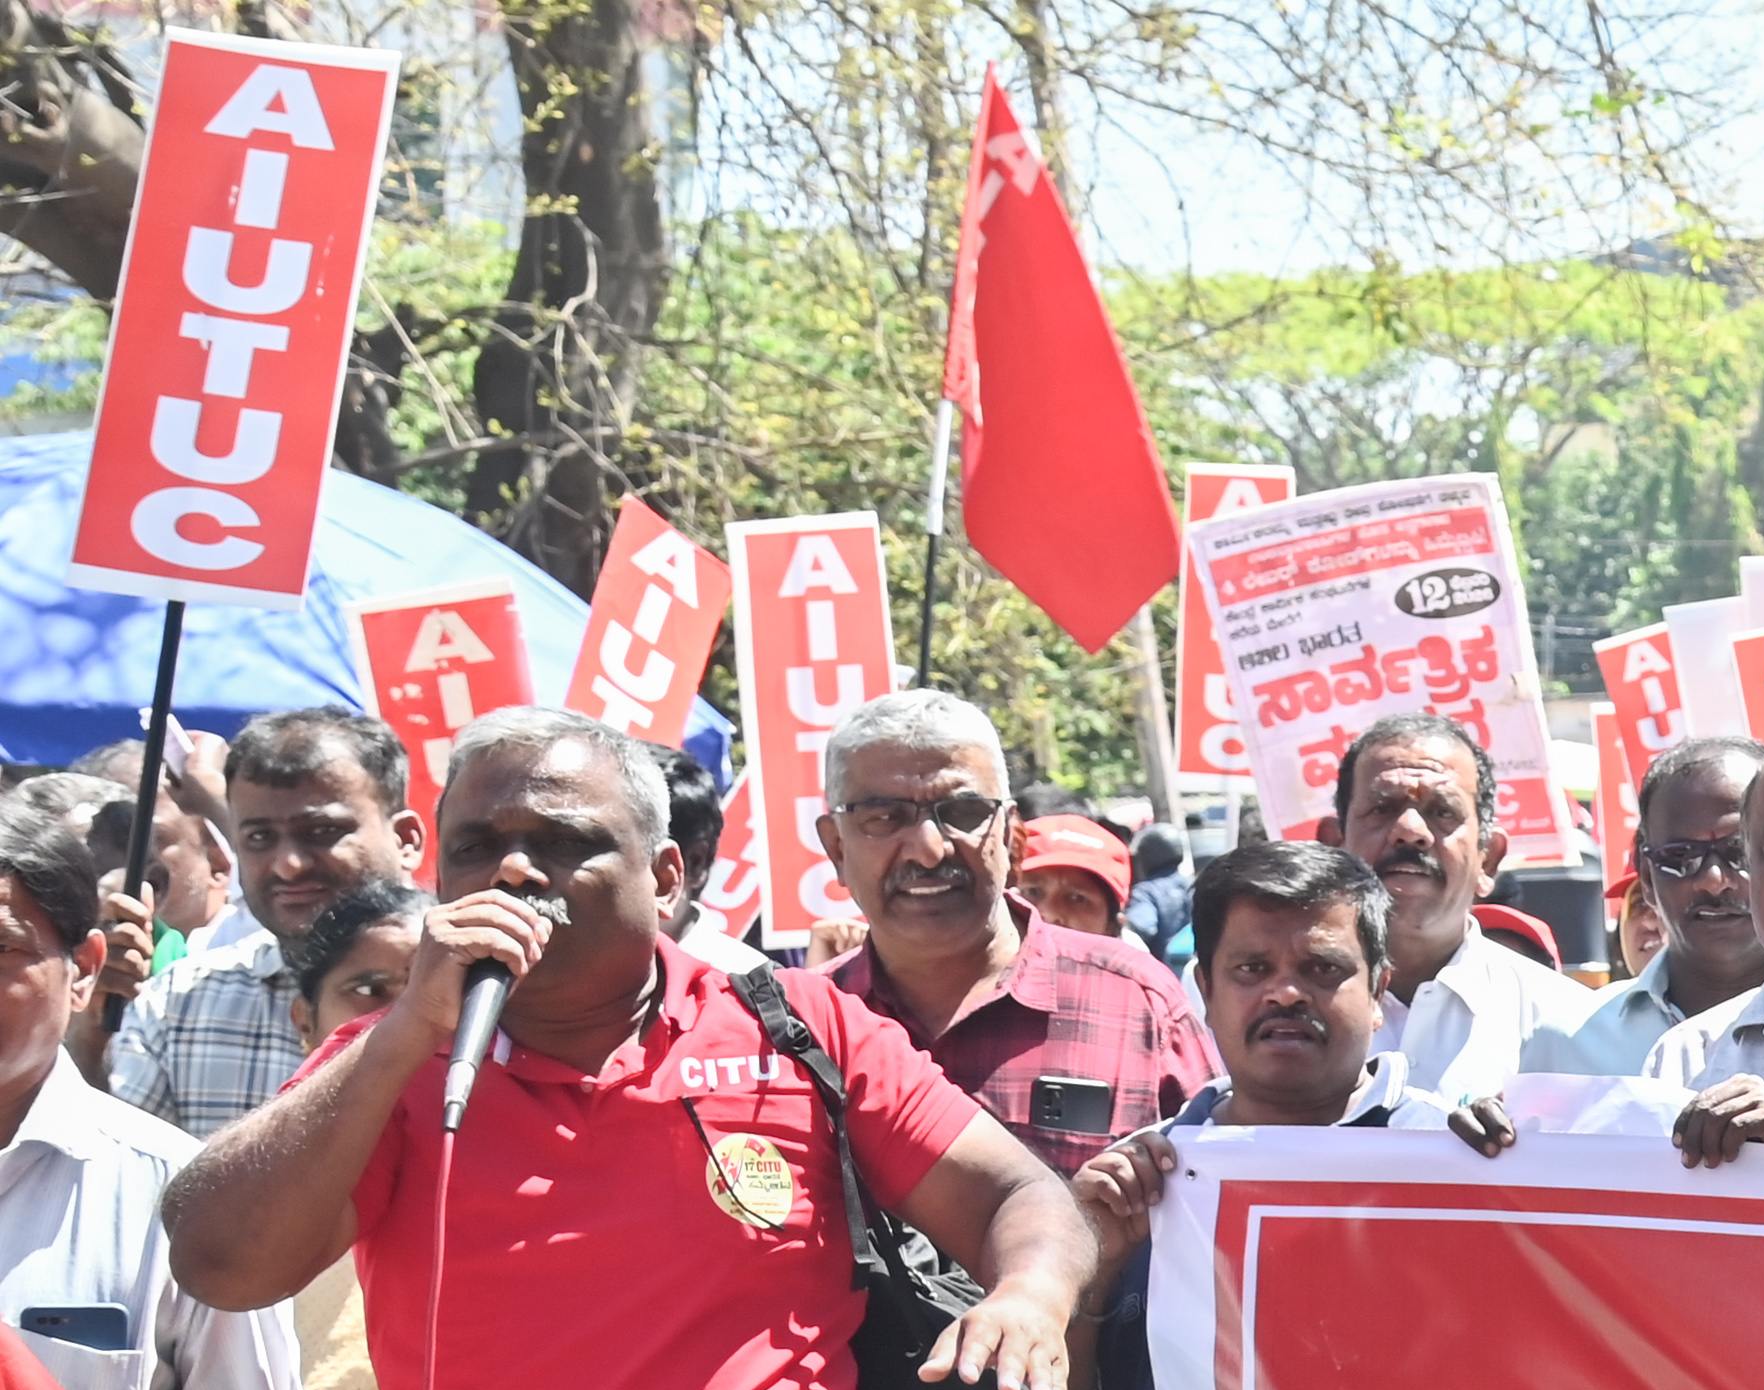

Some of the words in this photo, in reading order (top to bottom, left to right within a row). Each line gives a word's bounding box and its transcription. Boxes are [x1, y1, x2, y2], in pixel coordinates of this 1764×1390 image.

[130, 65, 334, 570] AIUTUC
[590, 528, 700, 734] AIUT
[1404, 579, 1450, 614] 12
[1252, 624, 1498, 728] ಸಾರ್ವತ್ರಿಕ
[680, 1053, 780, 1088] CITU
